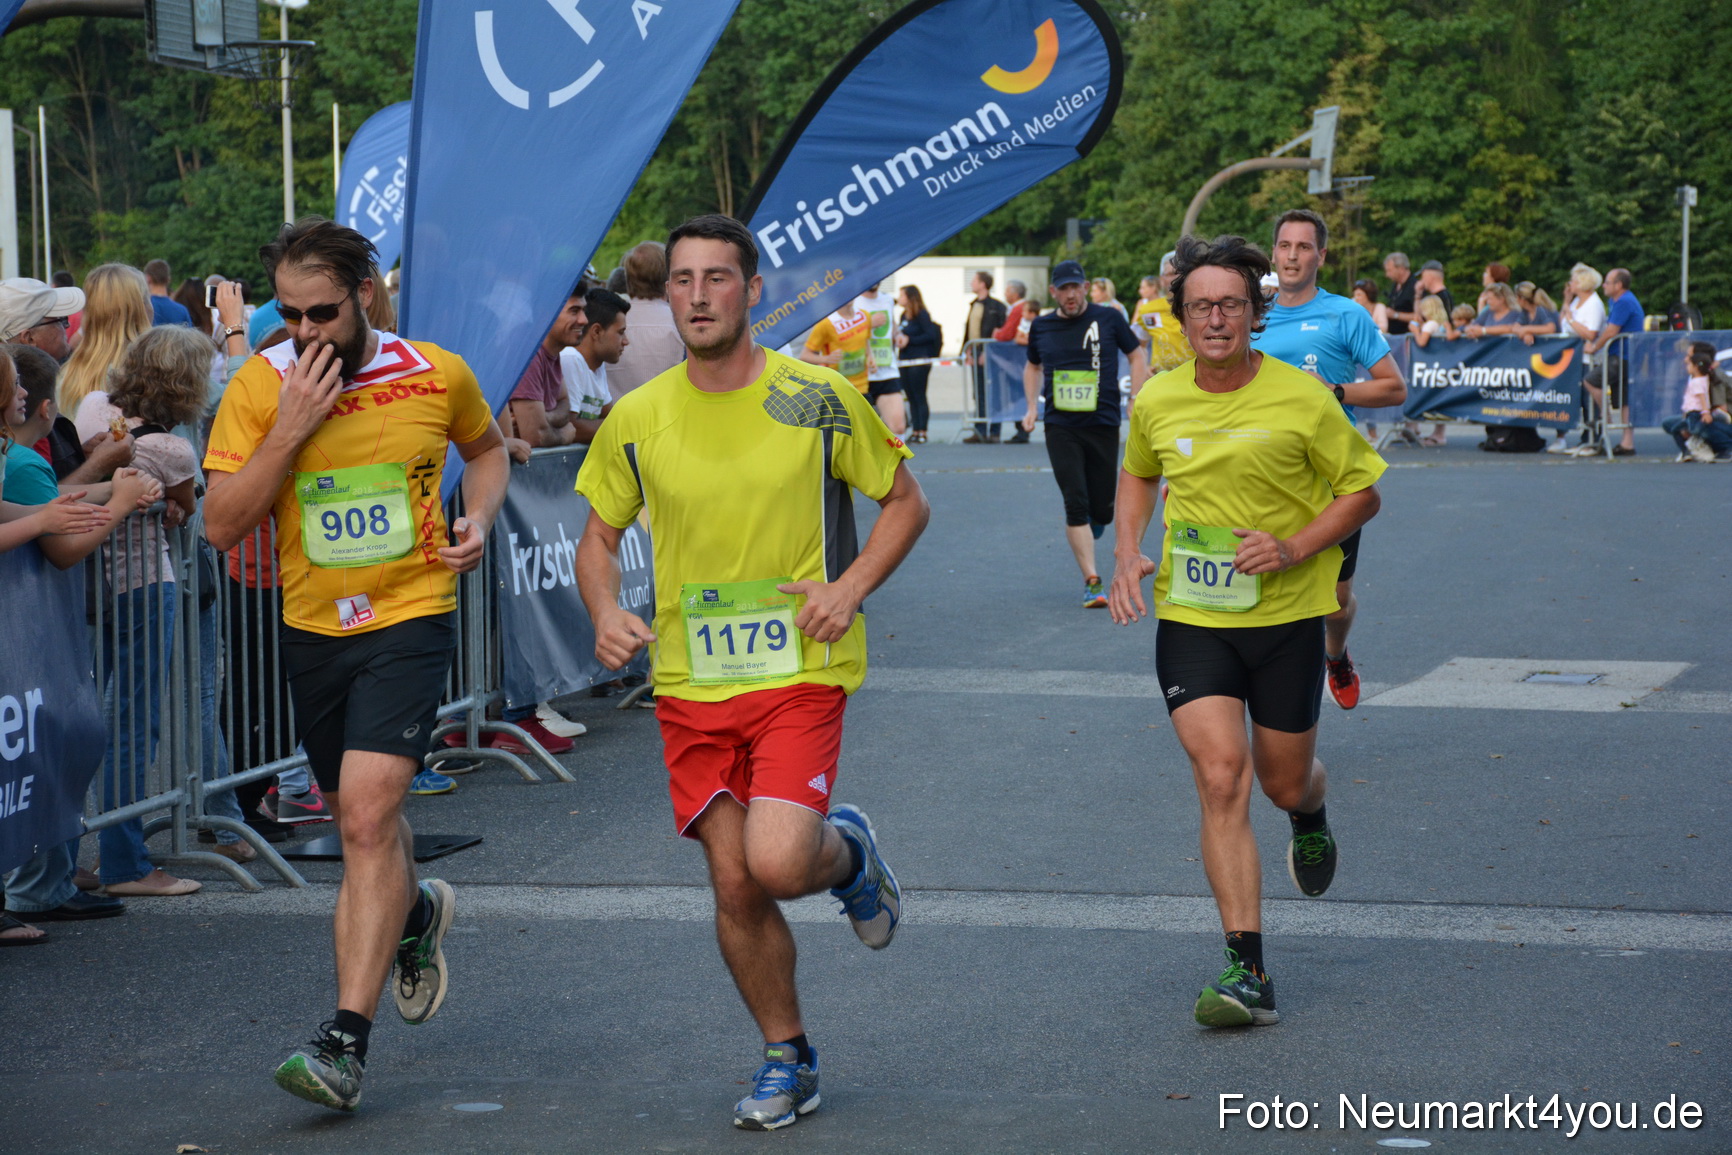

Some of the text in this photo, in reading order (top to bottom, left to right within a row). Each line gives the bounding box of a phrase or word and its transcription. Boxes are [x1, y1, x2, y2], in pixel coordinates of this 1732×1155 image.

[922, 84, 1097, 198] Druck und Medien
[756, 101, 1012, 269] Frischmann
[1411, 361, 1533, 389] Frischmann
[324, 380, 448, 421] AX BÖGL
[1057, 386, 1093, 400] 1157
[320, 503, 391, 542] 908
[331, 543, 388, 555] Alexander Kropp
[1186, 557, 1237, 588] 607
[696, 619, 788, 656] 1179
[746, 661, 767, 670] Bayer
